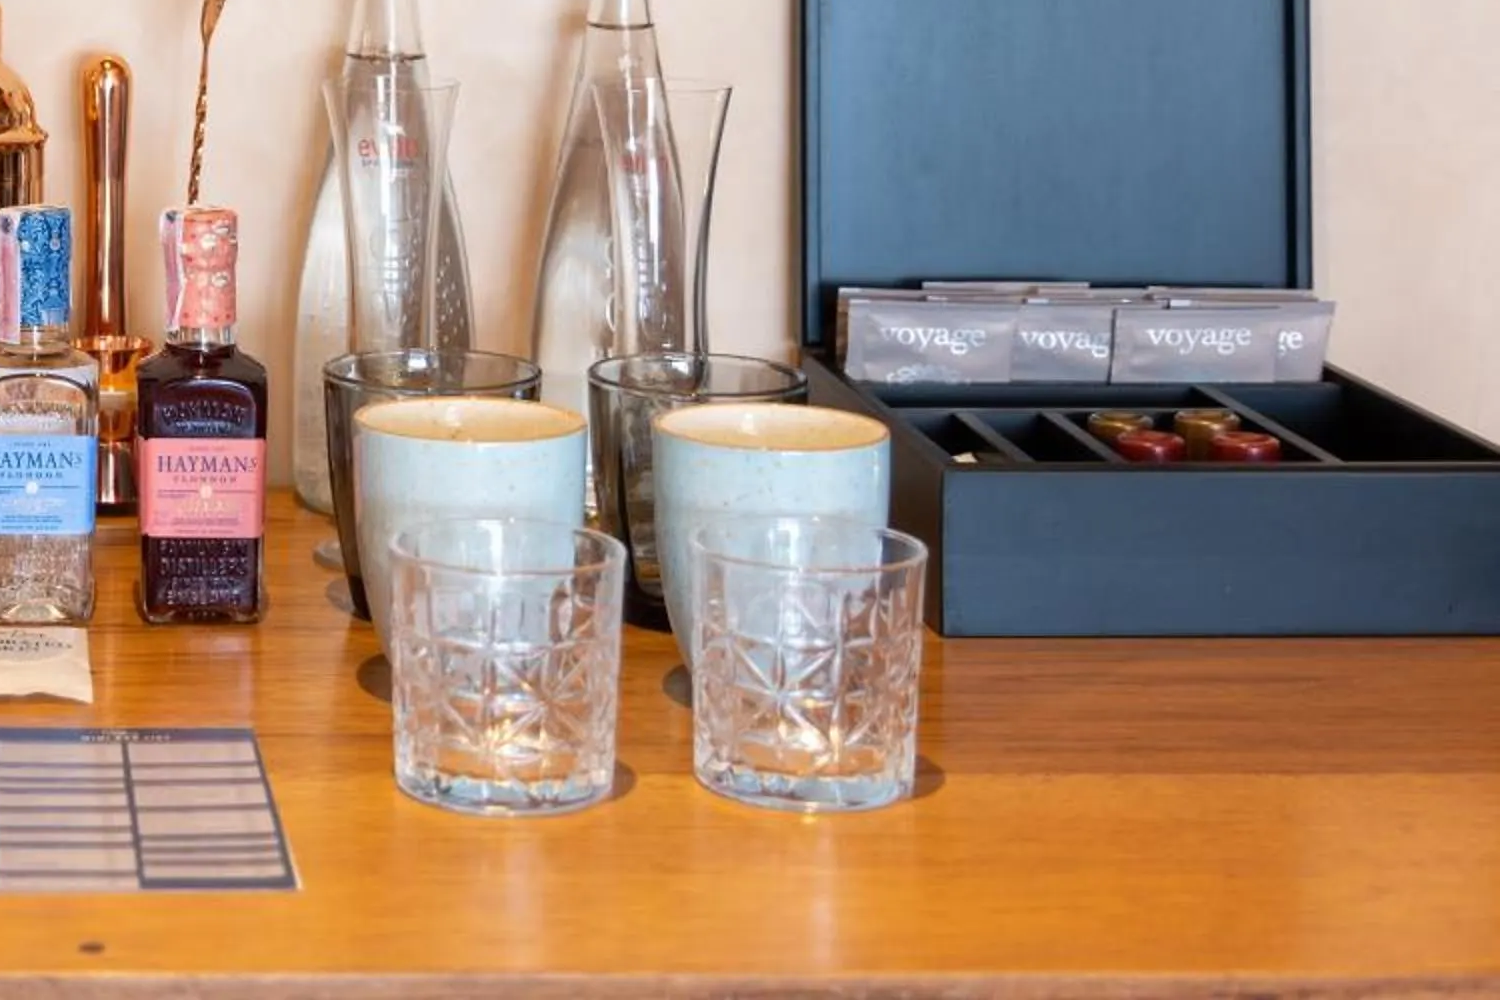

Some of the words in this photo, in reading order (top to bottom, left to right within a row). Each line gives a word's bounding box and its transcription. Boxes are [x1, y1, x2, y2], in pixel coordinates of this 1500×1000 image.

[880, 326, 986, 355] voyage
[1020, 328, 1112, 358] voyag
[1146, 325, 1252, 355] voyage
